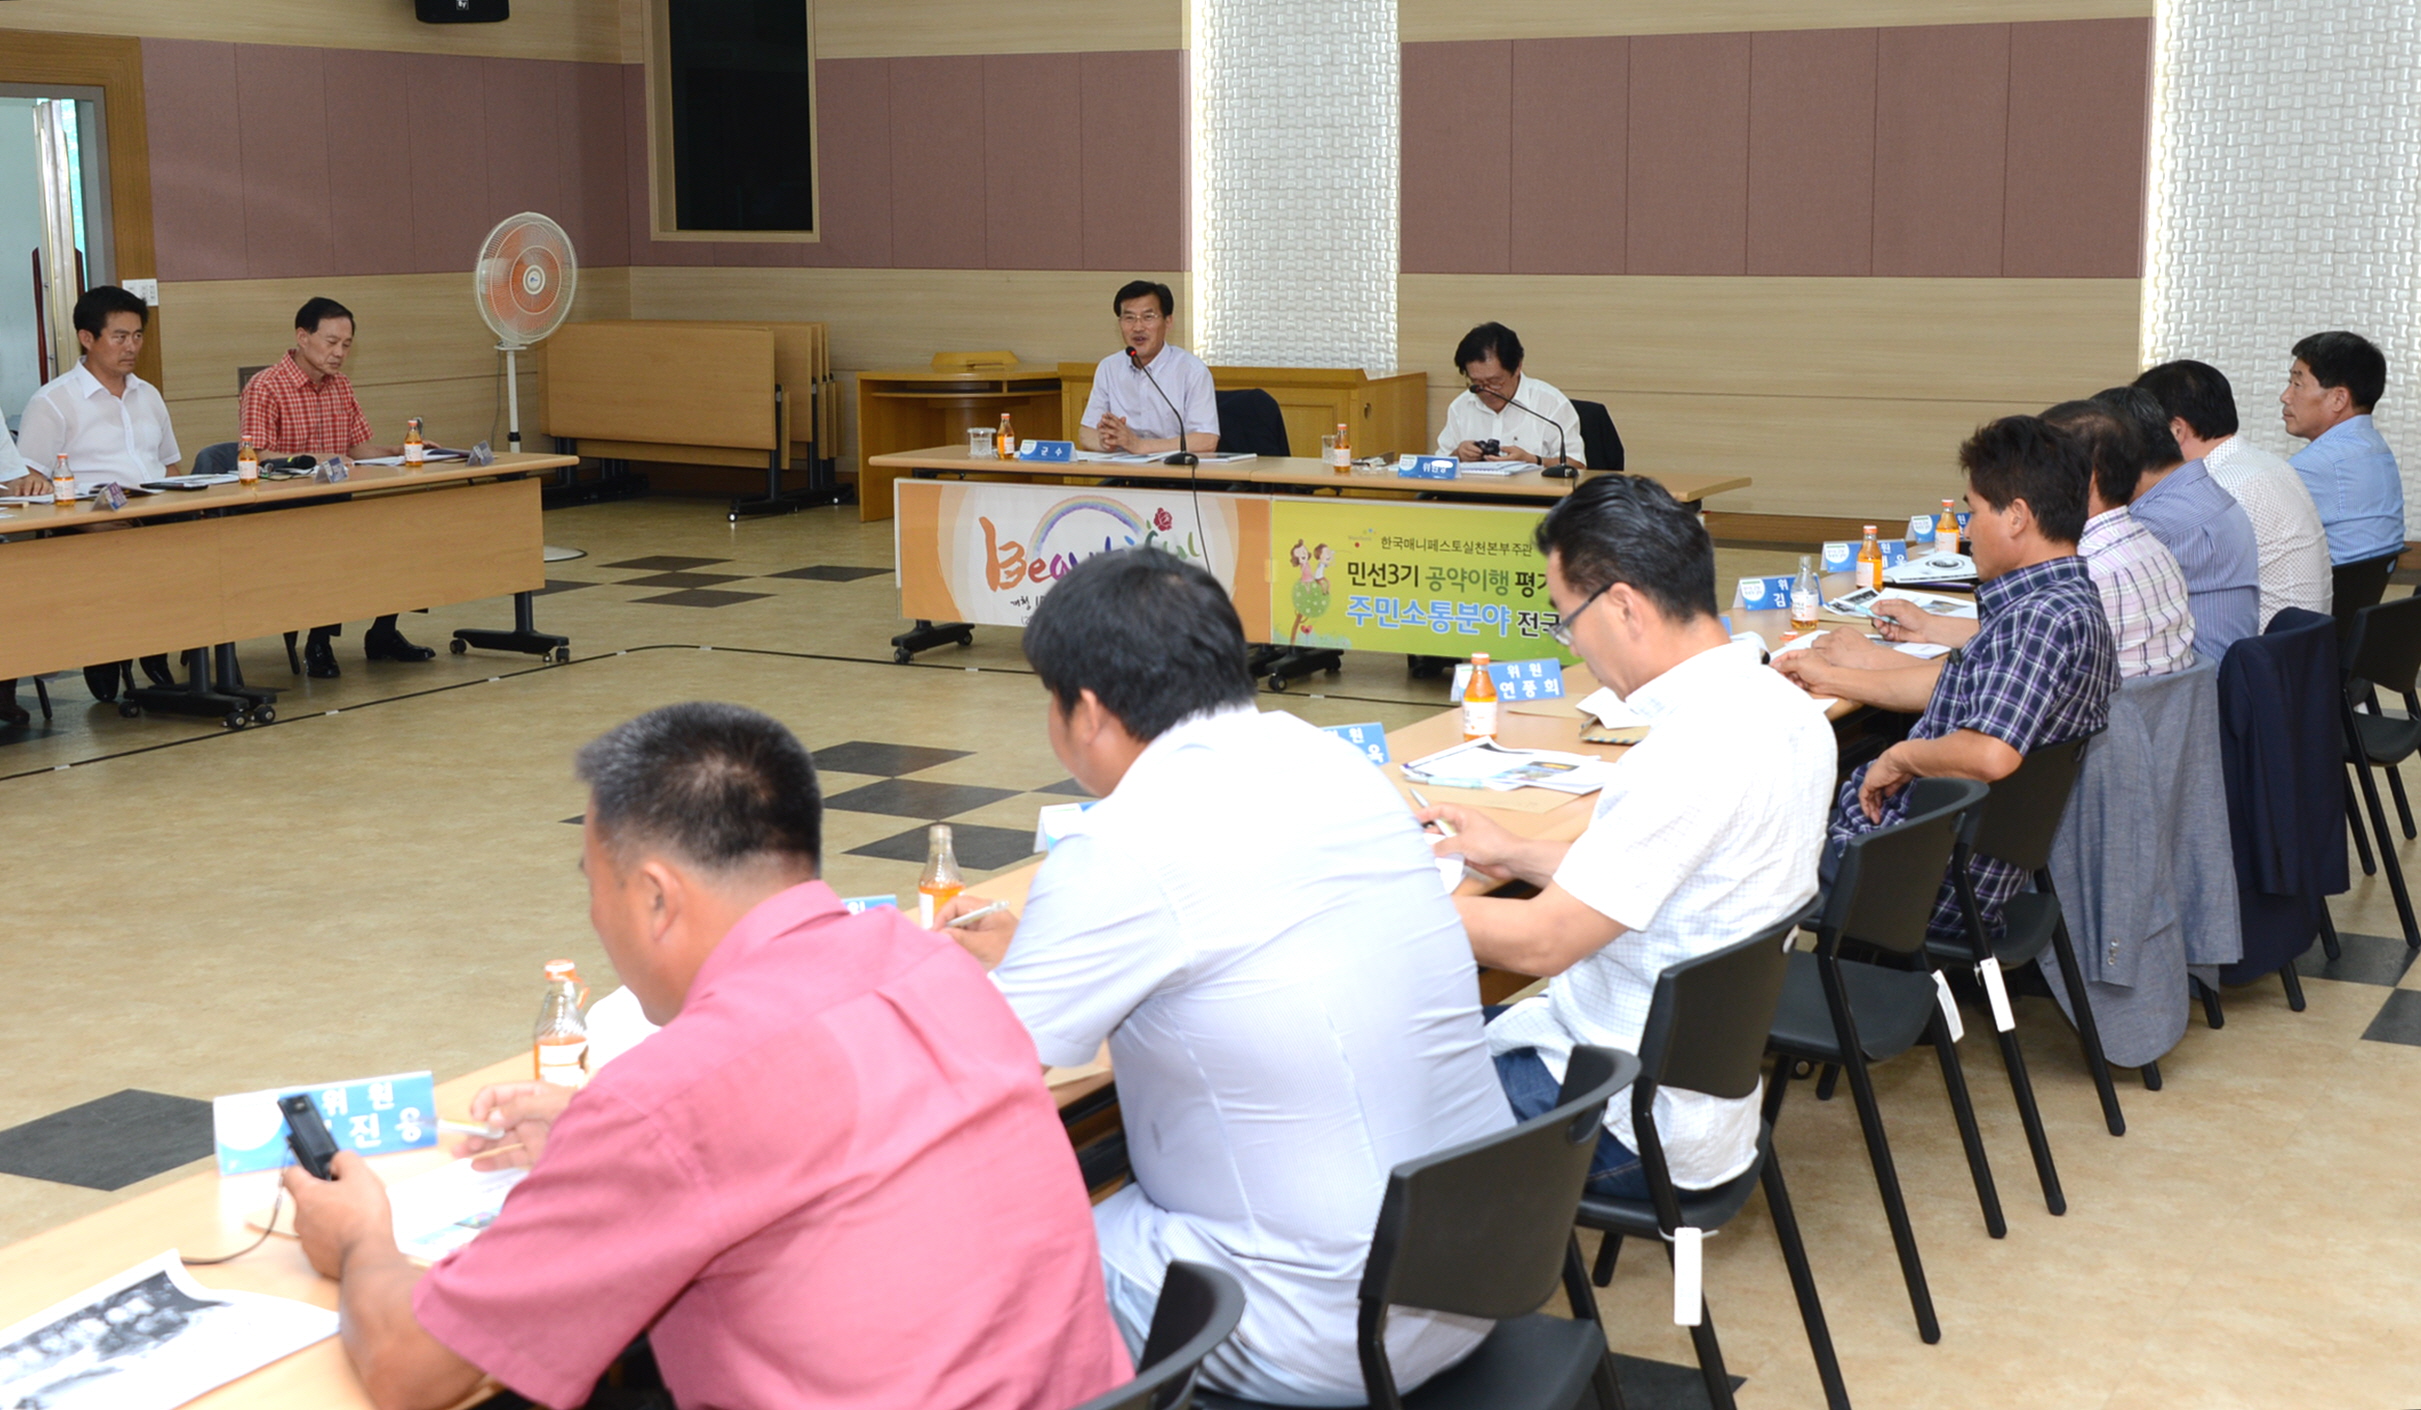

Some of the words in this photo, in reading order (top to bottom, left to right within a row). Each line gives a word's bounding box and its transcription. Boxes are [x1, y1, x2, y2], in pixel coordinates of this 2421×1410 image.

[1347, 561, 1420, 588] 민선3기
[1425, 566, 1510, 597] 공약이행
[1346, 595, 1511, 636] 주민소통분야
